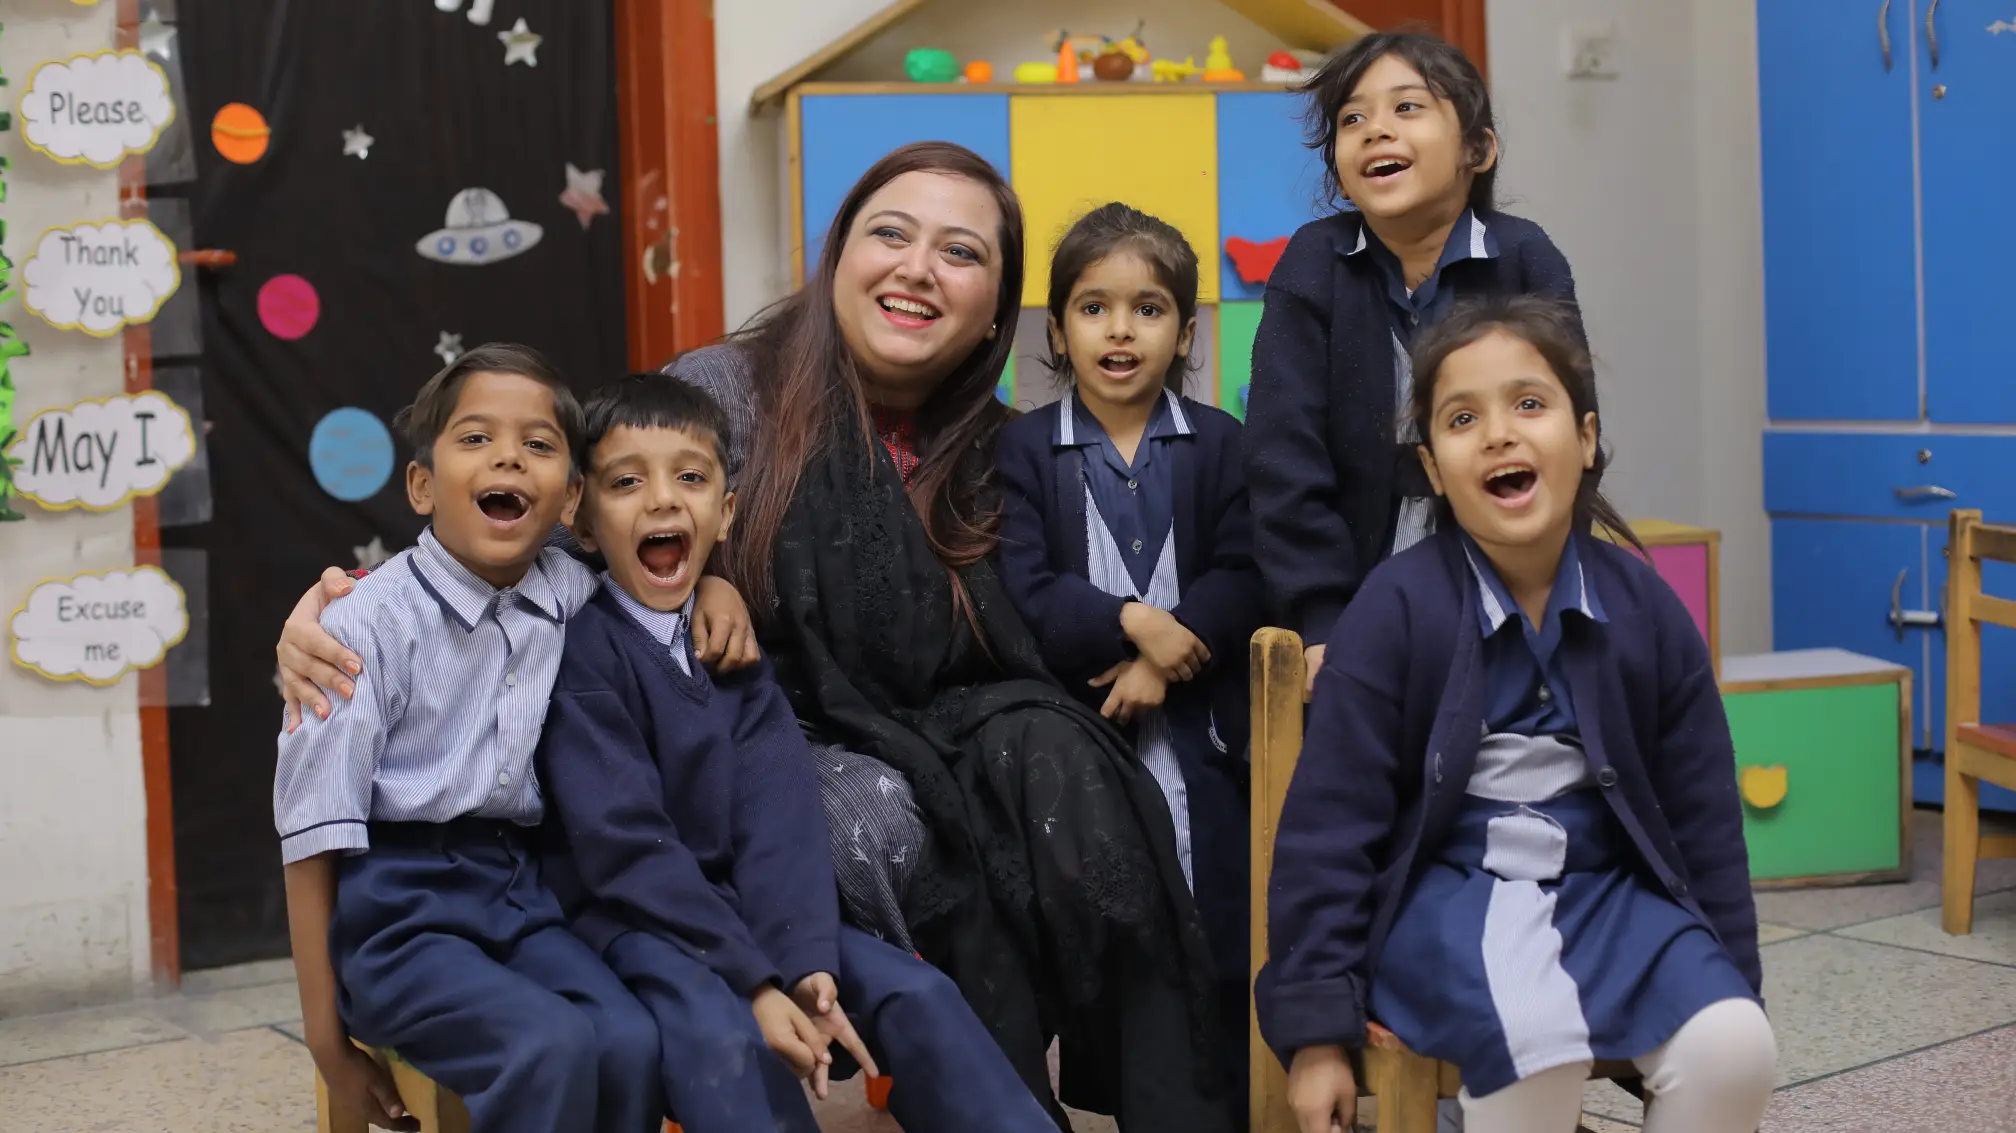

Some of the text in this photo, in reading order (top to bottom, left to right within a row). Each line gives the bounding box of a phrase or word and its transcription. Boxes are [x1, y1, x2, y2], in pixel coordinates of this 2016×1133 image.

[49, 92, 143, 125] Please
[60, 236, 139, 266] Thank
[73, 287, 124, 316] You
[32, 412, 156, 489] May I
[57, 596, 146, 621] Excuse
[84, 642, 120, 661] me
